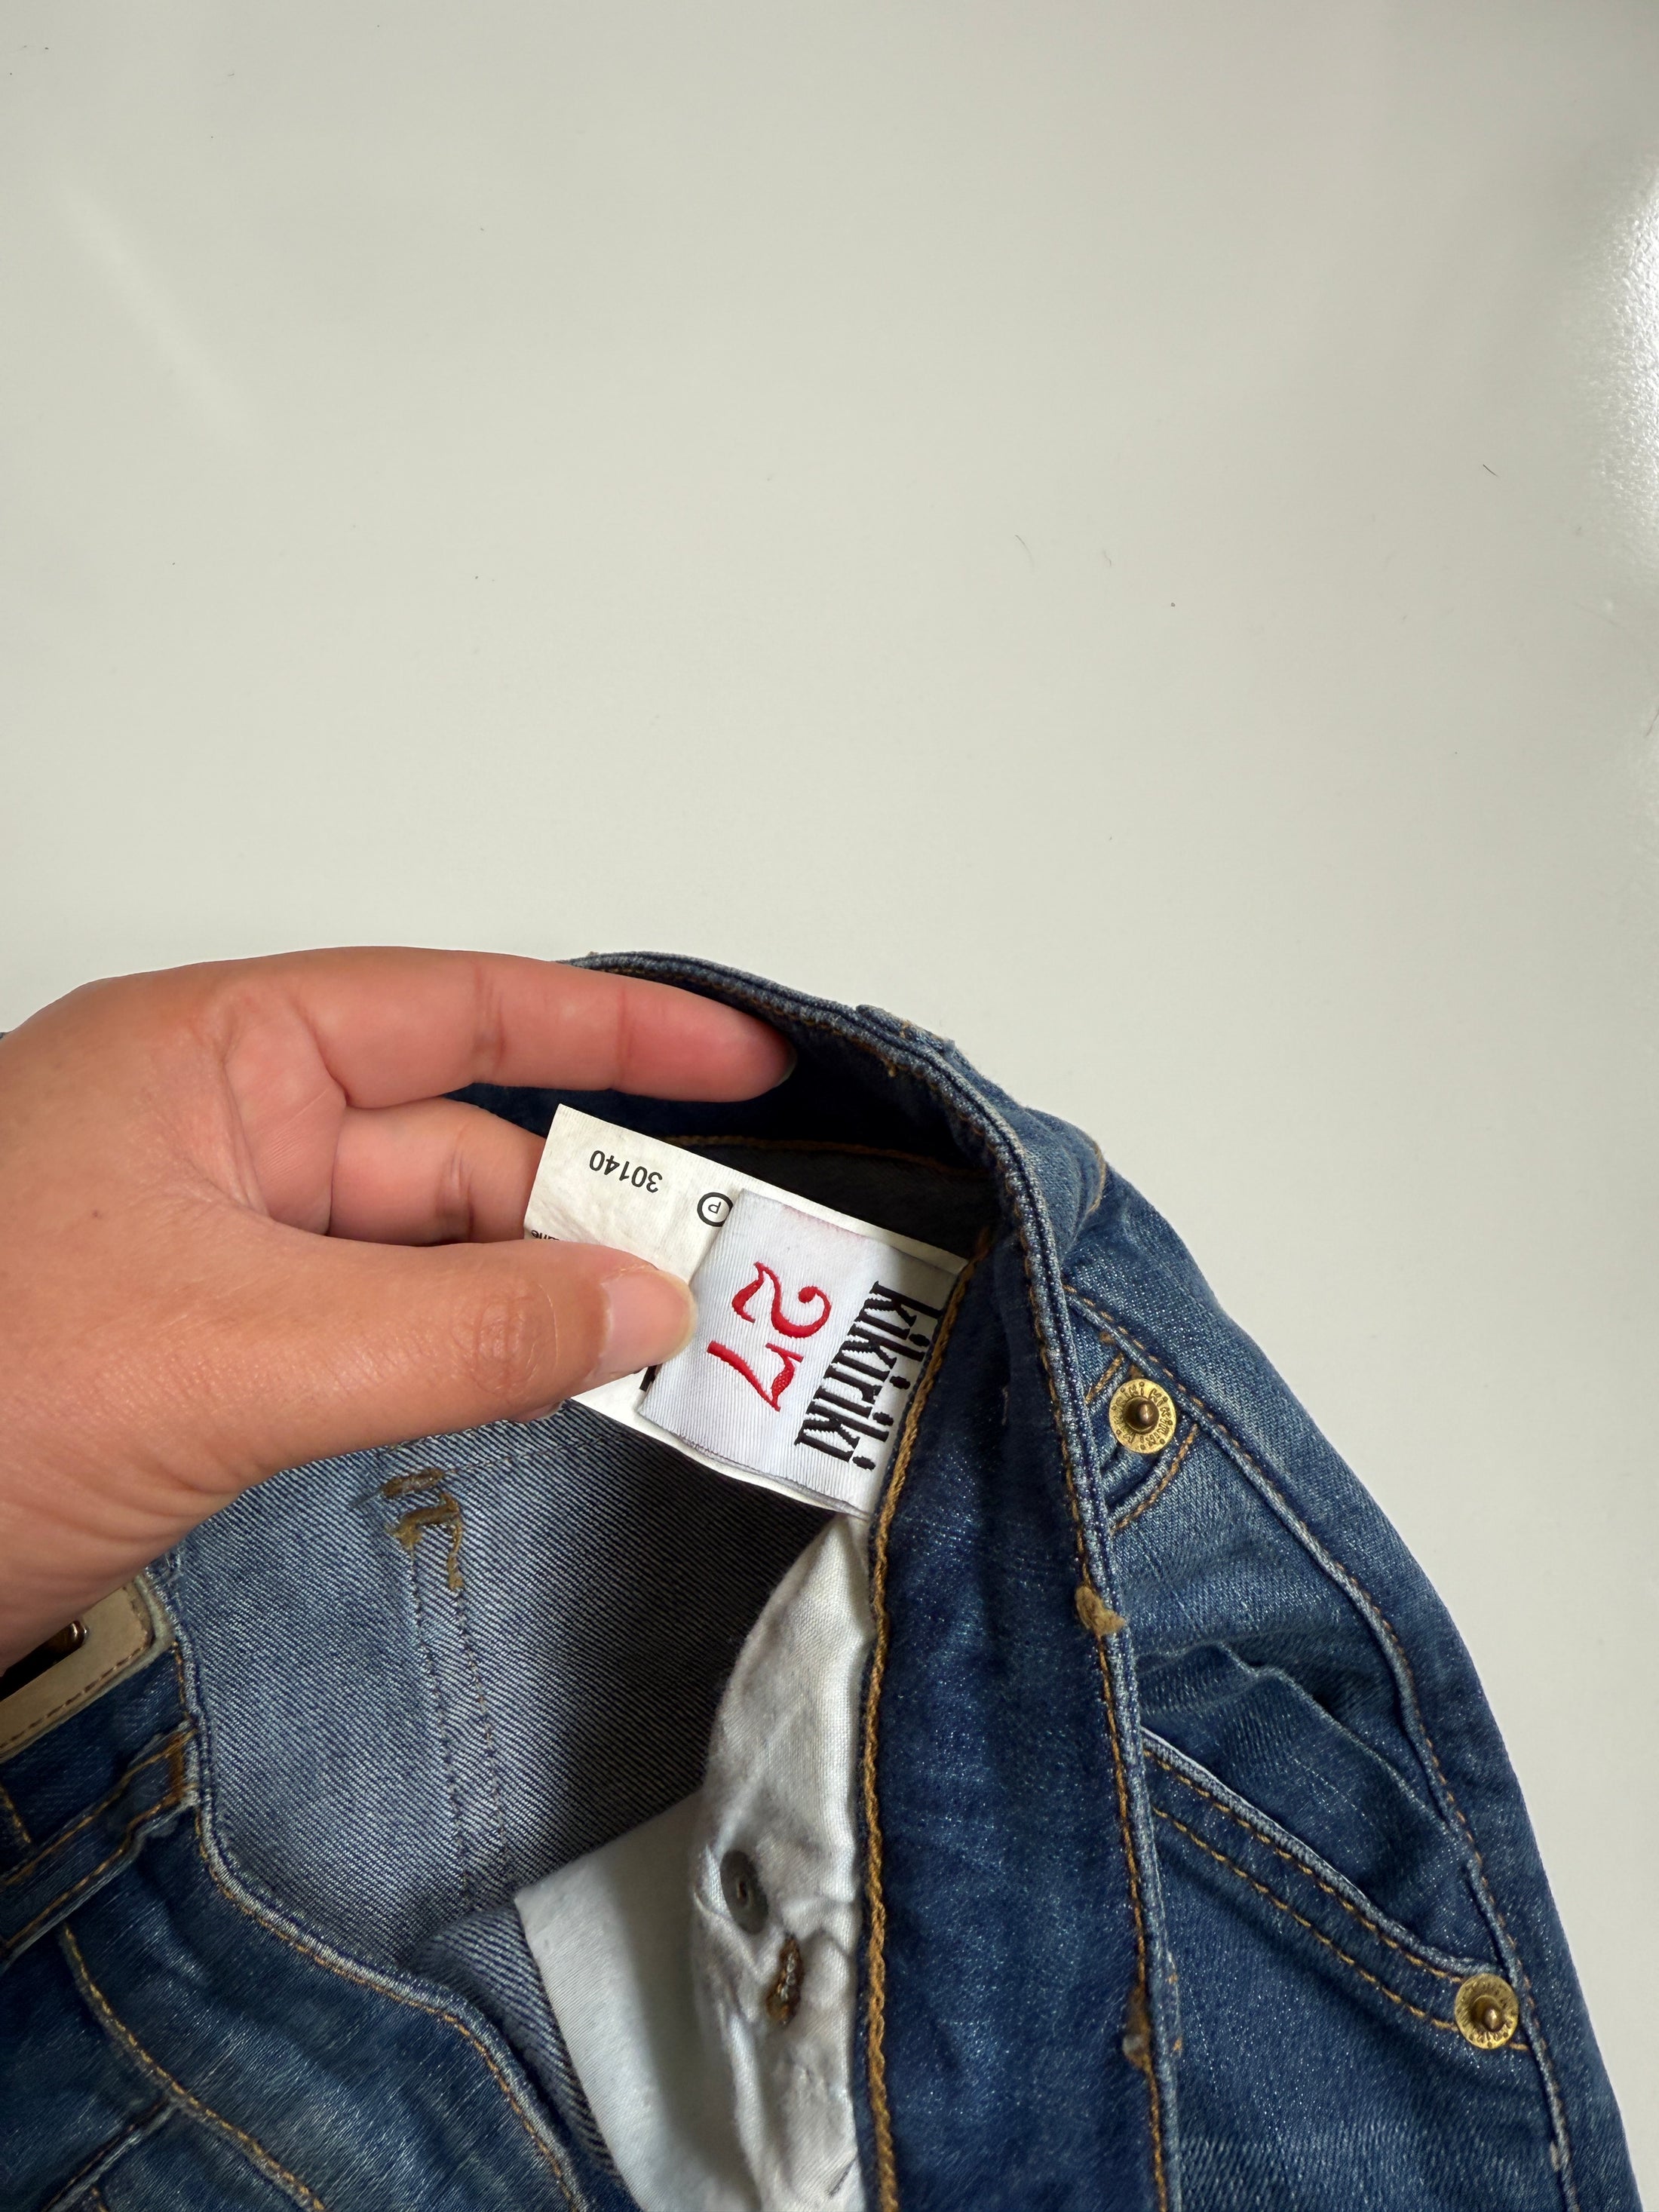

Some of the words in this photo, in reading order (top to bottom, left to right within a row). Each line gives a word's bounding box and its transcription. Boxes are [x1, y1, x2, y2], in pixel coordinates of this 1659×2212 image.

[589, 1150, 663, 1193] 30140
[707, 1261, 831, 1412] 27
[794, 1281, 943, 1471] kikiriki
